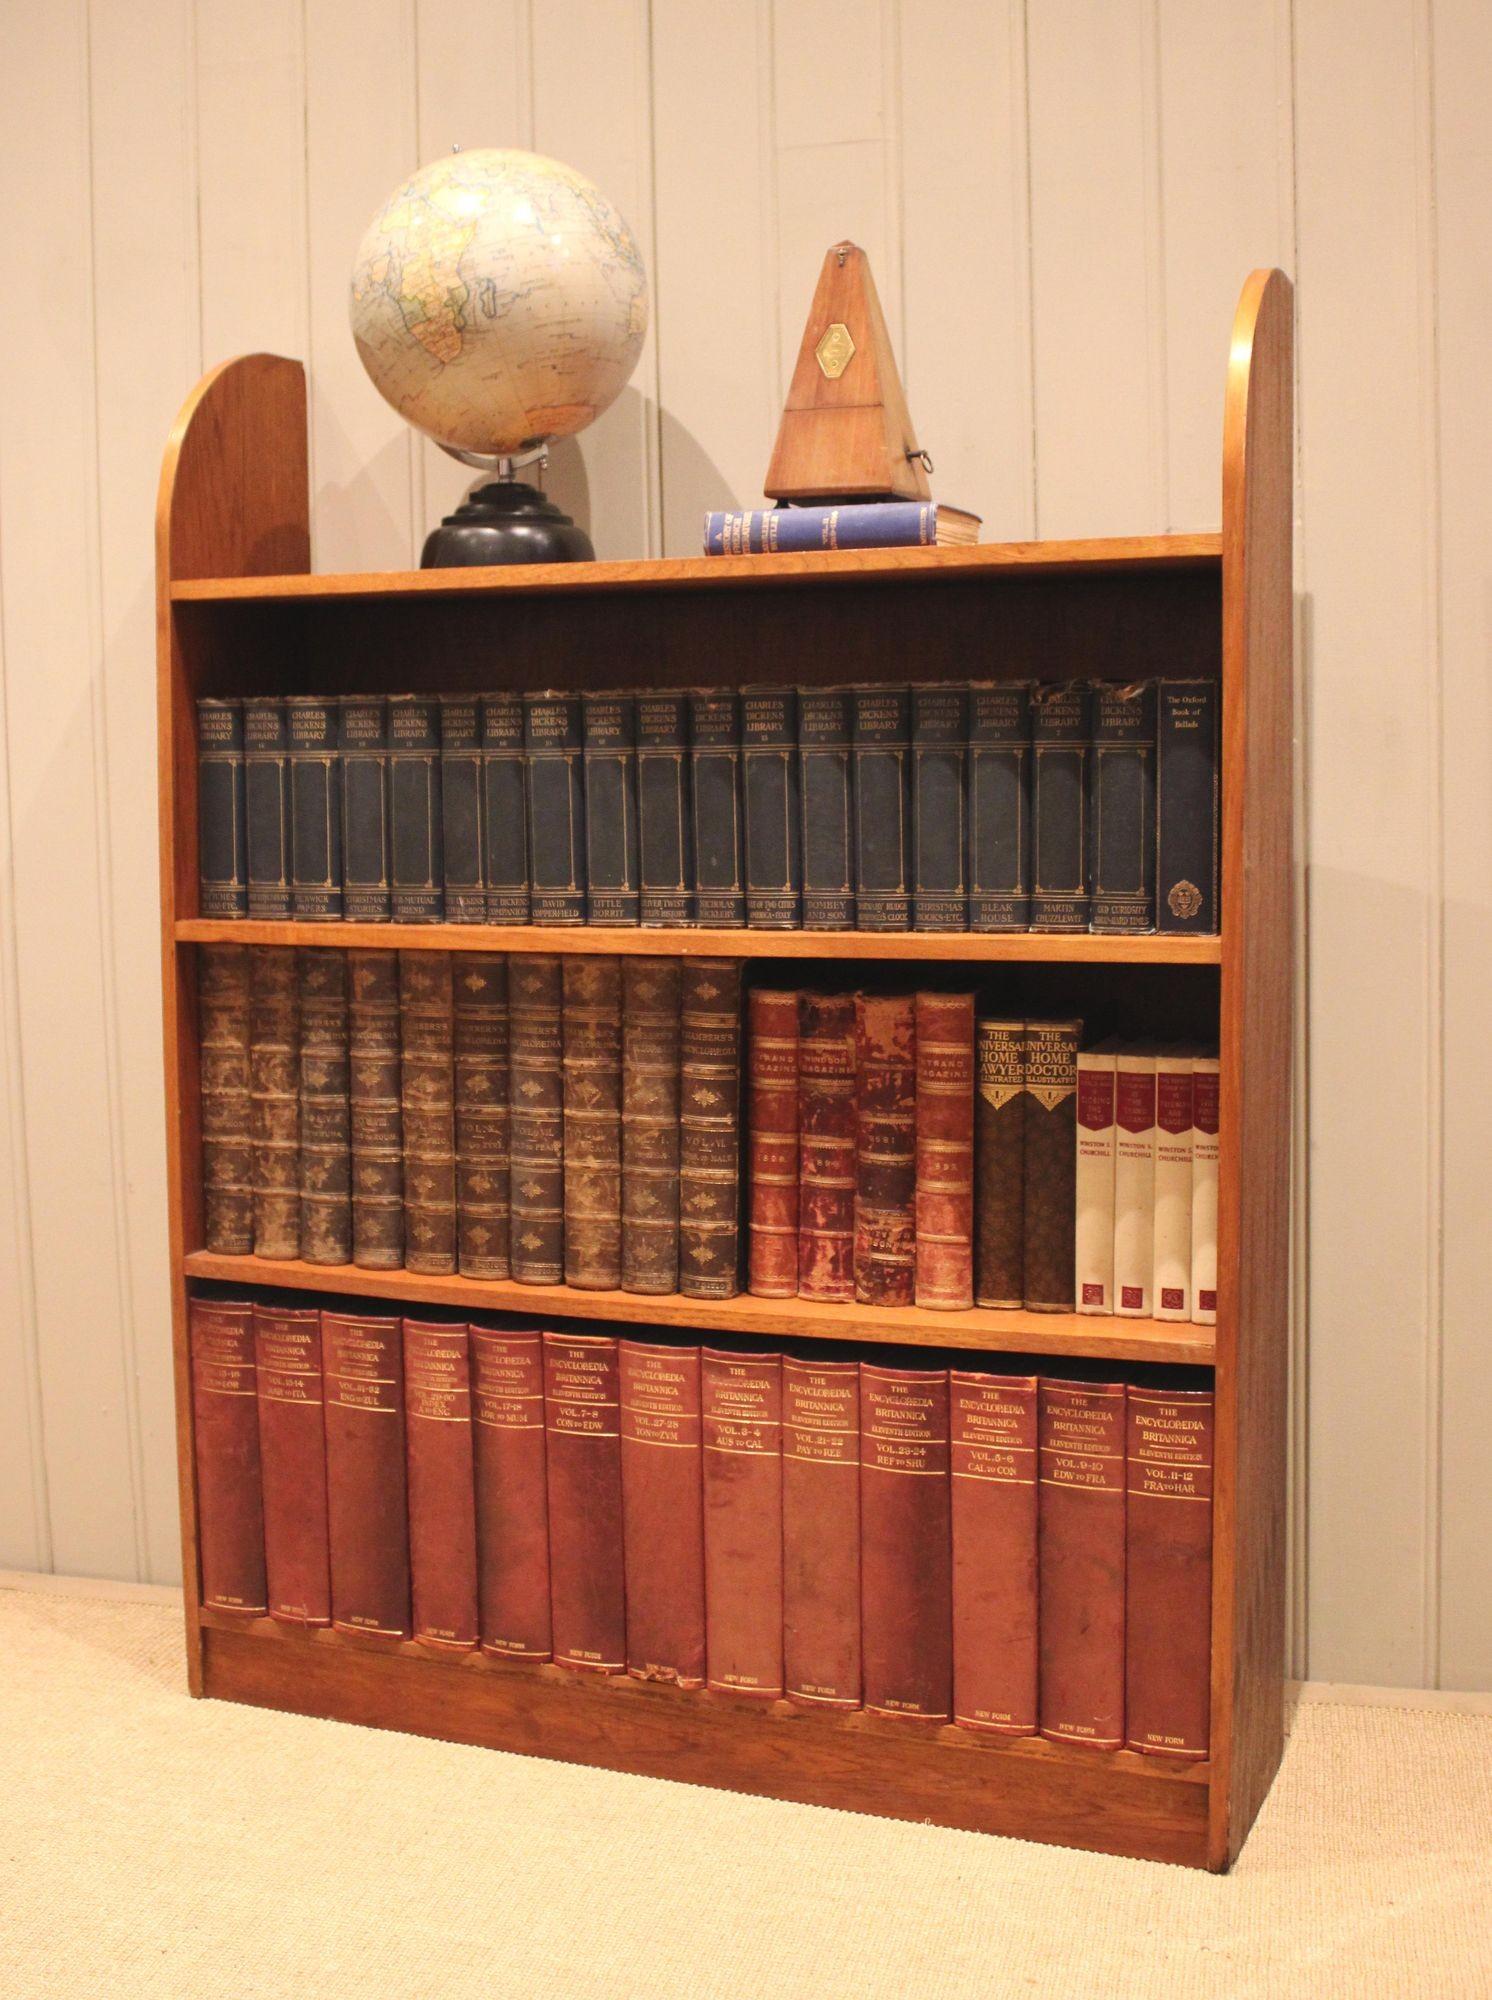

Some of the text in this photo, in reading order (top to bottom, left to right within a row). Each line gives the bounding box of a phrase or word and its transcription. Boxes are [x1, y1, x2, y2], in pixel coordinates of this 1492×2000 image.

[1182, 695, 1207, 704] Oxford
[1172, 707, 1190, 715] Book
[746, 722, 783, 731] LIBRARY
[859, 720, 898, 730] LIBRARY
[293, 731, 325, 740] LIBRARY
[346, 730, 380, 738] LIBRARY
[393, 729, 427, 737] LIBRARY
[487, 728, 520, 737] LIBRARY
[531, 727, 568, 737] LIBRARY
[542, 899, 565, 908] DAVID
[593, 898, 622, 908] LITTLE
[916, 902, 964, 912] CHRISTMAS
[981, 903, 1014, 912] BLEAK
[1043, 903, 1075, 912] MARTIN
[592, 909, 626, 918] DORRIT
[1111, 905, 1148, 915] CURIOSITY
[807, 911, 847, 920] AND SON
[887, 912, 909, 921] CLOCK
[979, 912, 1014, 923] HOUSE
[1035, 913, 1084, 923] CHUZZLEWIT
[987, 1031, 1010, 1040] THE
[1039, 1031, 1062, 1041] THE
[980, 1051, 1018, 1064] HOME
[1030, 1052, 1071, 1064] HOME
[980, 1062, 1025, 1076] AWYER
[1025, 1063, 1076, 1077] DOCTOR
[1079, 1140, 1105, 1148] WINSTON
[1118, 1142, 1146, 1150] WINSTON
[1079, 1149, 1111, 1157] CHURCHILL
[1158, 1146, 1187, 1154] WINSTON
[1118, 1151, 1152, 1159] CHURCHILL
[1158, 1155, 1194, 1163] CHURCHILL
[569, 1351, 585, 1359] THE
[646, 1360, 662, 1369] THE
[729, 1367, 746, 1376] THE
[555, 1372, 603, 1386] BRITANNICA
[809, 1376, 827, 1385] THE
[633, 1382, 679, 1396] BRITANNICA
[891, 1385, 909, 1394] THE
[715, 1390, 764, 1403] BRITANNICA
[982, 1391, 1000, 1400] THE
[795, 1398, 845, 1412] BRITANNICA
[1071, 1398, 1088, 1407] THE
[875, 1407, 927, 1422] BRITANNICA
[1158, 1407, 1178, 1417] THE
[556, 1418, 604, 1430] CON EDW
[966, 1414, 1018, 1429] BRITANNICA
[1053, 1421, 1106, 1435] BRITANNICA
[716, 1436, 765, 1449] AUS CAL
[1142, 1431, 1198, 1445] BRITANNICA
[796, 1444, 812, 1455] PAY
[1174, 1453, 1203, 1461] EDITION
[877, 1455, 926, 1469] REF SHU
[967, 1462, 1017, 1476] CAL CON
[1053, 1470, 1106, 1484] EDW FRA
[1143, 1480, 1196, 1494] FRA HAR
[724, 1674, 738, 1683] NEW
[801, 1684, 815, 1693] NEW
[885, 1699, 900, 1708] NEW
[975, 1710, 1011, 1721] NEW FORM
[1059, 1723, 1095, 1735] NEW FORM
[1147, 1733, 1185, 1745] NEW FORM
